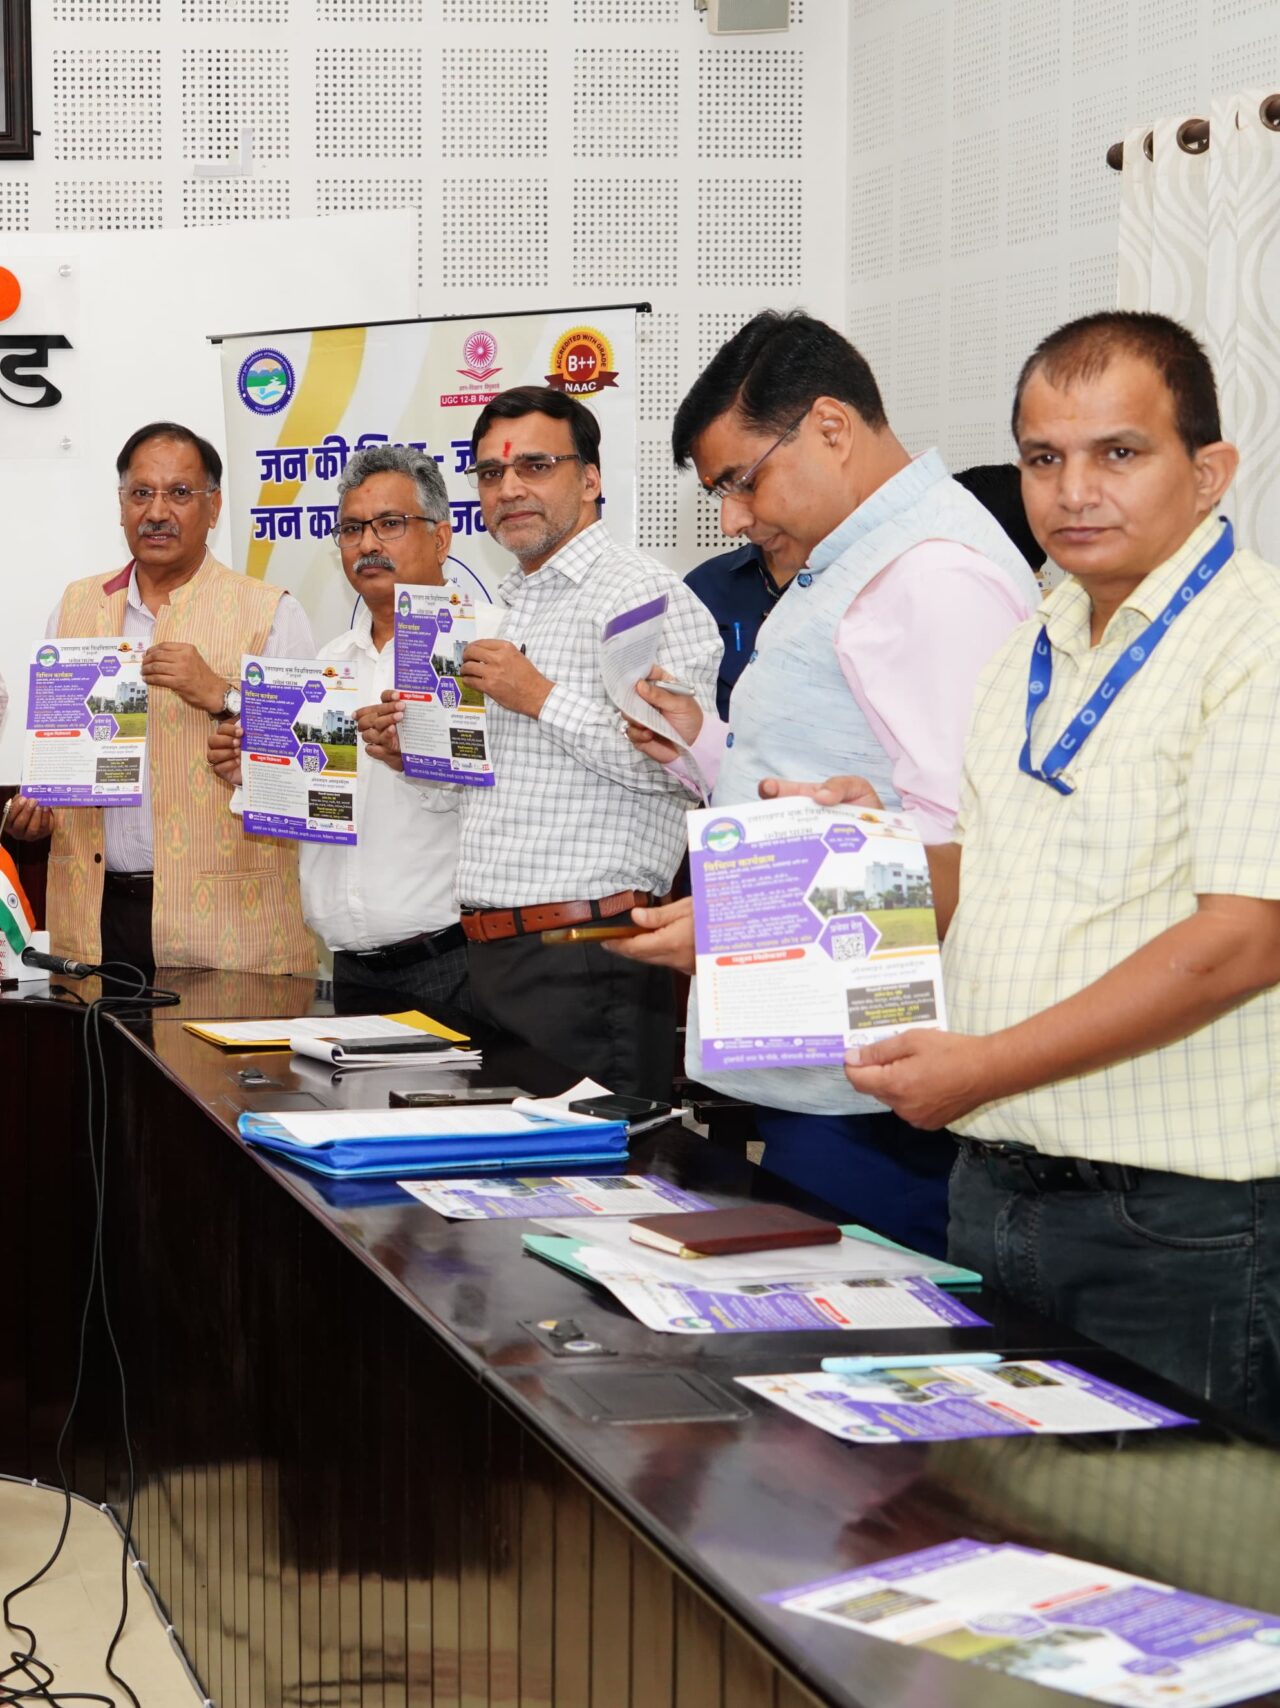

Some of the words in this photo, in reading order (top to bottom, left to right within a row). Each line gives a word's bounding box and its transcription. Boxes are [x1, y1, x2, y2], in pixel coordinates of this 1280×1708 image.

[557, 334, 580, 368] ACCREDITED
[582, 334, 597, 344] WITH
[596, 344, 607, 368] GRADE
[568, 355, 596, 372] B++
[442, 396, 458, 404] UGC
[460, 395, 476, 404] 12-B
[565, 382, 597, 392] NAAC
[256, 448, 308, 482] जन
[312, 434, 350, 480] की
[250, 506, 303, 540] जन
